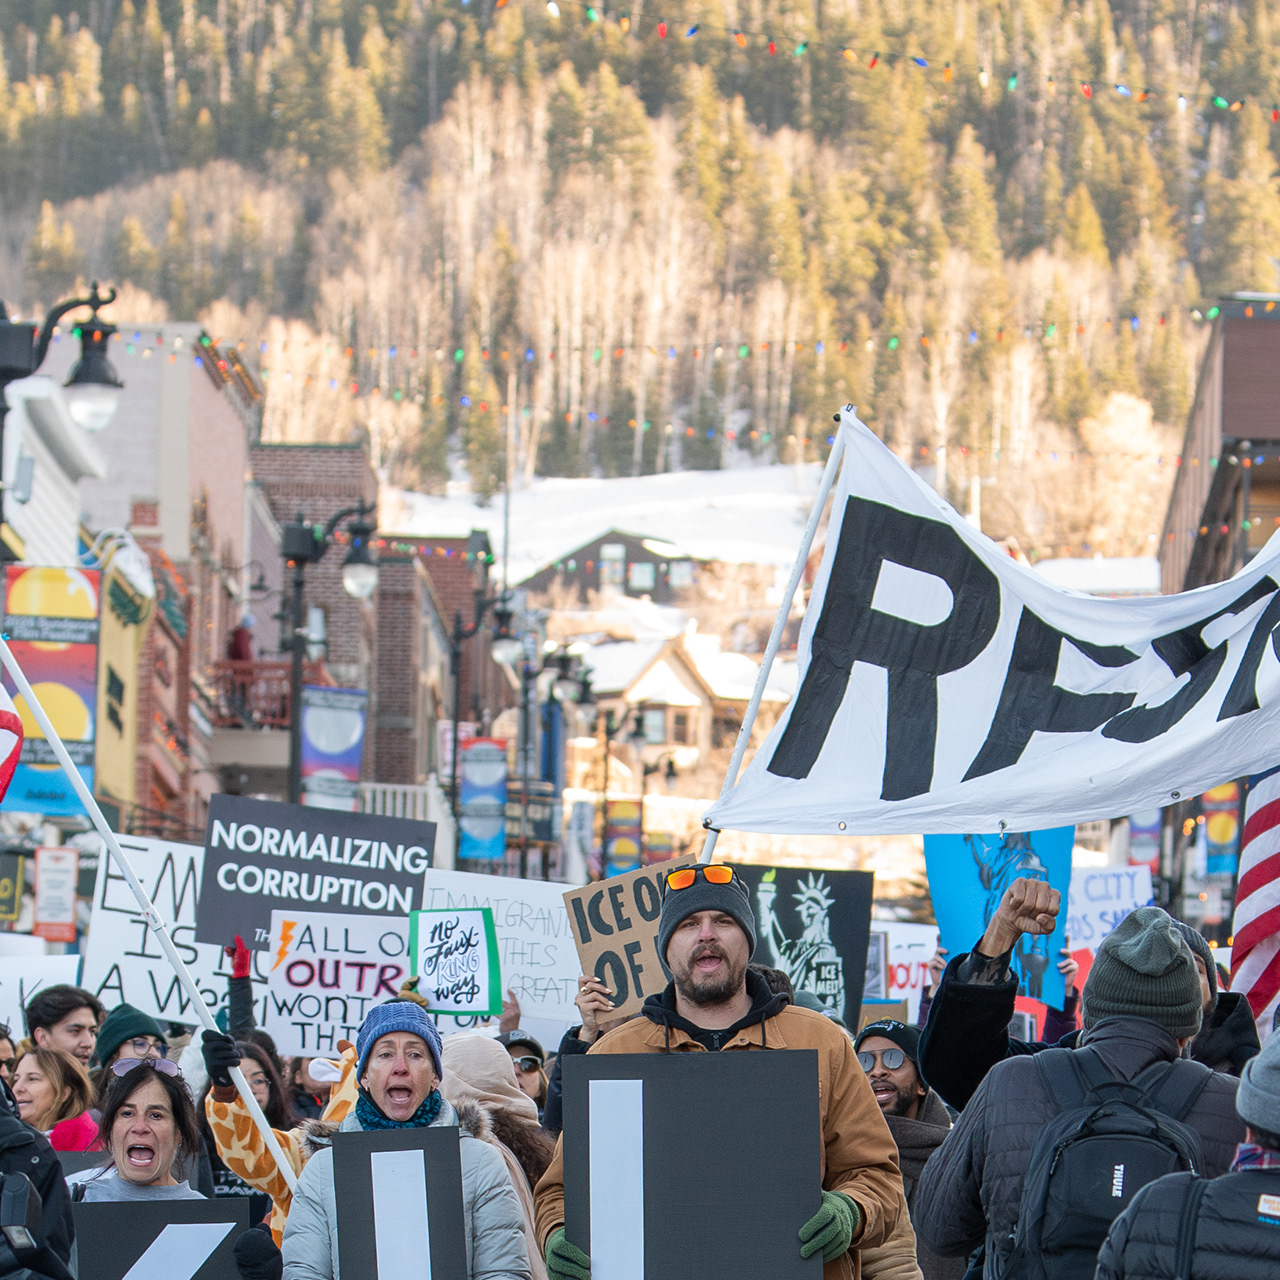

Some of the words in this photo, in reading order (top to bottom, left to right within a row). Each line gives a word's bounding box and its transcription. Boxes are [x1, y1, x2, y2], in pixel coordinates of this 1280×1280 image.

[210, 819, 429, 874] NORMALIZING
[217, 862, 414, 913] CORRUPTION
[1085, 871, 1138, 901] CITY
[571, 884, 632, 944] ICE
[124, 919, 198, 965] IS
[296, 924, 366, 953] ALL
[500, 937, 558, 967] THIS
[95, 963, 126, 1004] A
[437, 949, 480, 986] KING
[594, 940, 645, 1008] OF
[821, 964, 837, 980] ICE
[432, 974, 480, 1004] way
[508, 974, 577, 1004] GREAT
[816, 980, 839, 995] MELT
[1111, 1164, 1124, 1198] THULE
